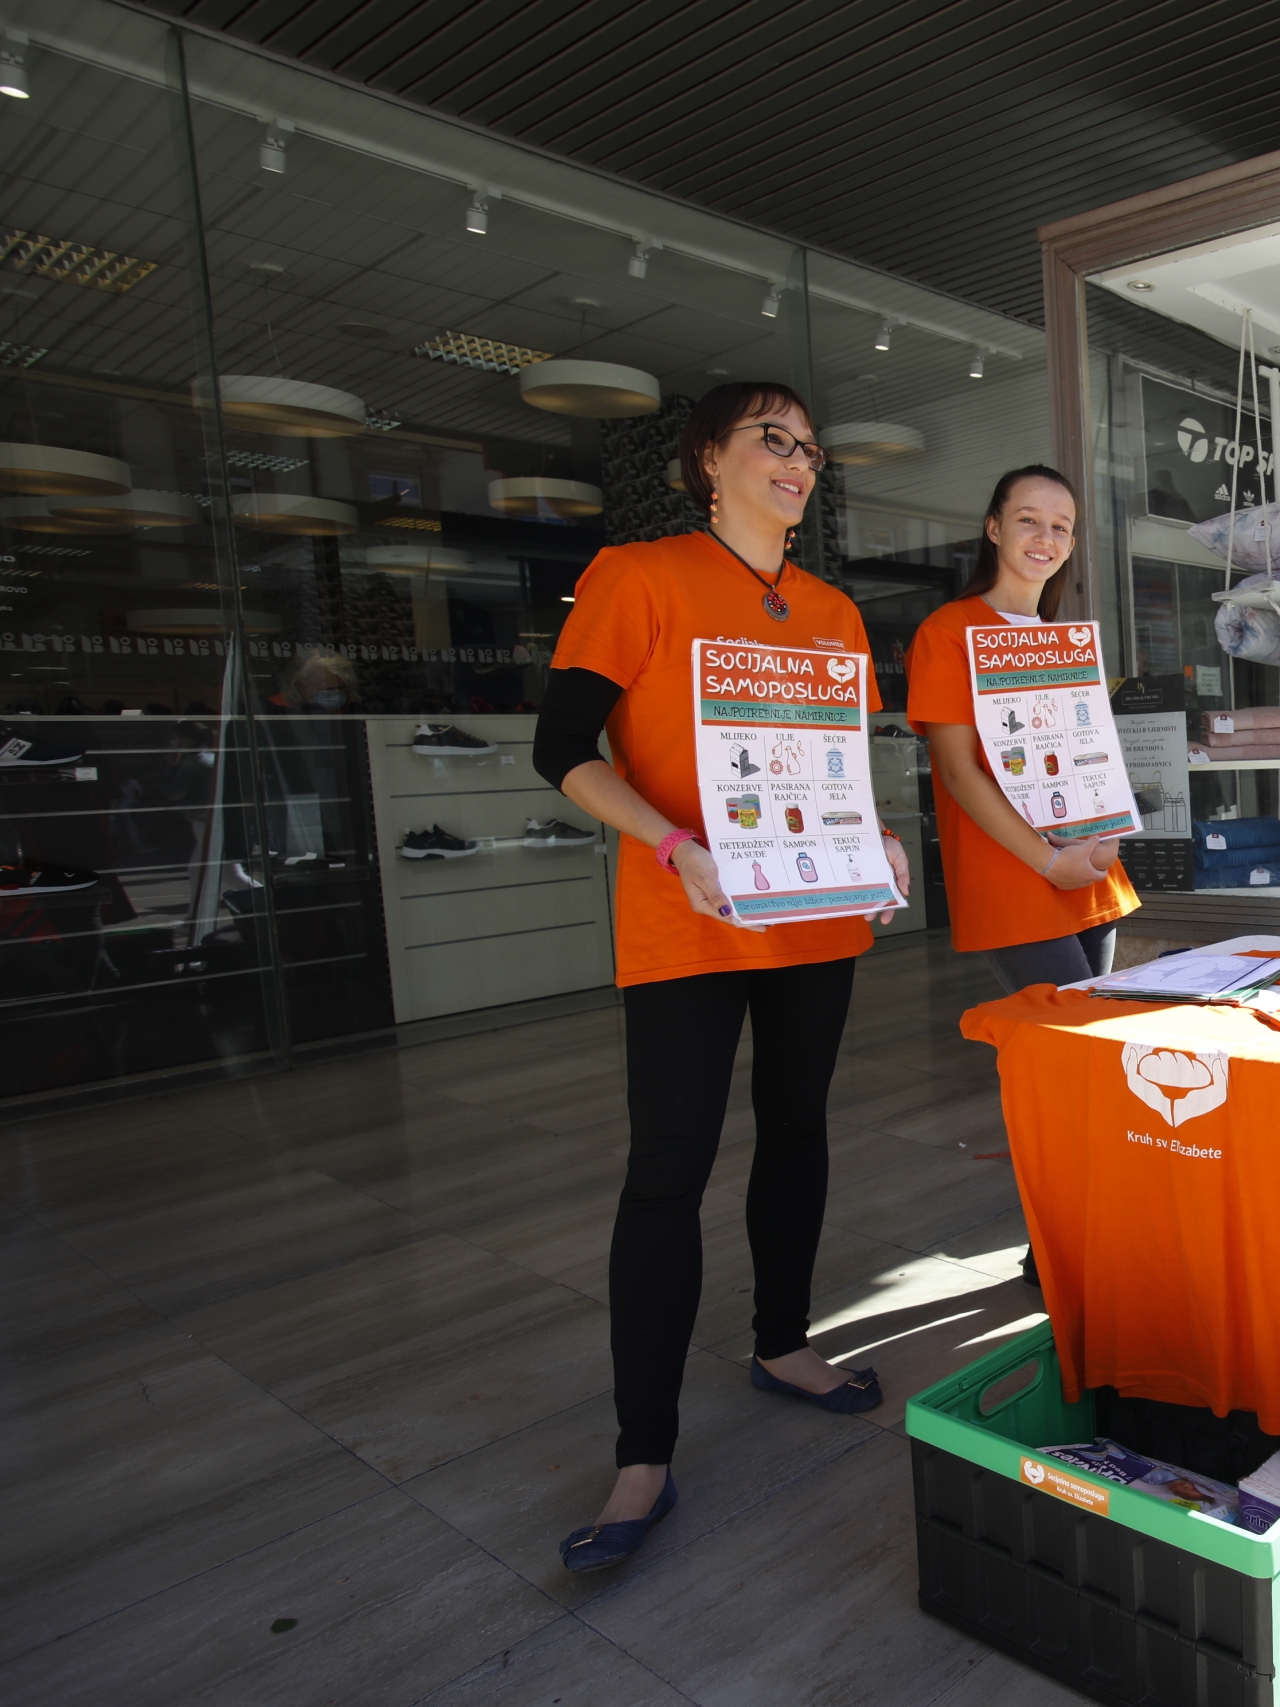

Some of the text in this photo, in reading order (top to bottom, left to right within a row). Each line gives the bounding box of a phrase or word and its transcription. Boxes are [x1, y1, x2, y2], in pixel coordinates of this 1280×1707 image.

[1213, 436, 1254, 468] TOP
[976, 631, 1060, 649] SOCIJALNA
[705, 649, 815, 676] SOCIJALNA
[979, 649, 1096, 669] SAMOPOSLUGA
[986, 671, 1089, 687] NAJPOTREBNIJE NAMIRNICE:
[705, 676, 858, 703] SAMOPOSLUGA
[992, 697, 1022, 705] MLIJEKO
[713, 705, 848, 722] NAJPOTREBNIJE NAMIRNICE:
[720, 732, 757, 741] MLIJEKO
[776, 733, 795, 742] ULJE
[1033, 733, 1064, 742] PASIRANA
[1072, 729, 1100, 738] GOTOVA
[993, 738, 1027, 748] KONZERVE
[1079, 737, 1094, 745] JELA
[717, 784, 763, 792] KONZERVE
[770, 783, 811, 791] PASIRANA
[821, 783, 853, 791] GOTOVA
[1042, 780, 1069, 789] ŠAMPON
[1084, 780, 1106, 788] SAPUN
[829, 792, 847, 800] JELA
[719, 838, 775, 850] DETERDŽENT
[783, 838, 817, 848] ŠAMPON
[835, 844, 860, 853] SAPUN
[730, 851, 743, 860] ZA
[1127, 1130, 1153, 1146] Kruh
[1047, 1472, 1105, 1502] Socijalna samoposluga
